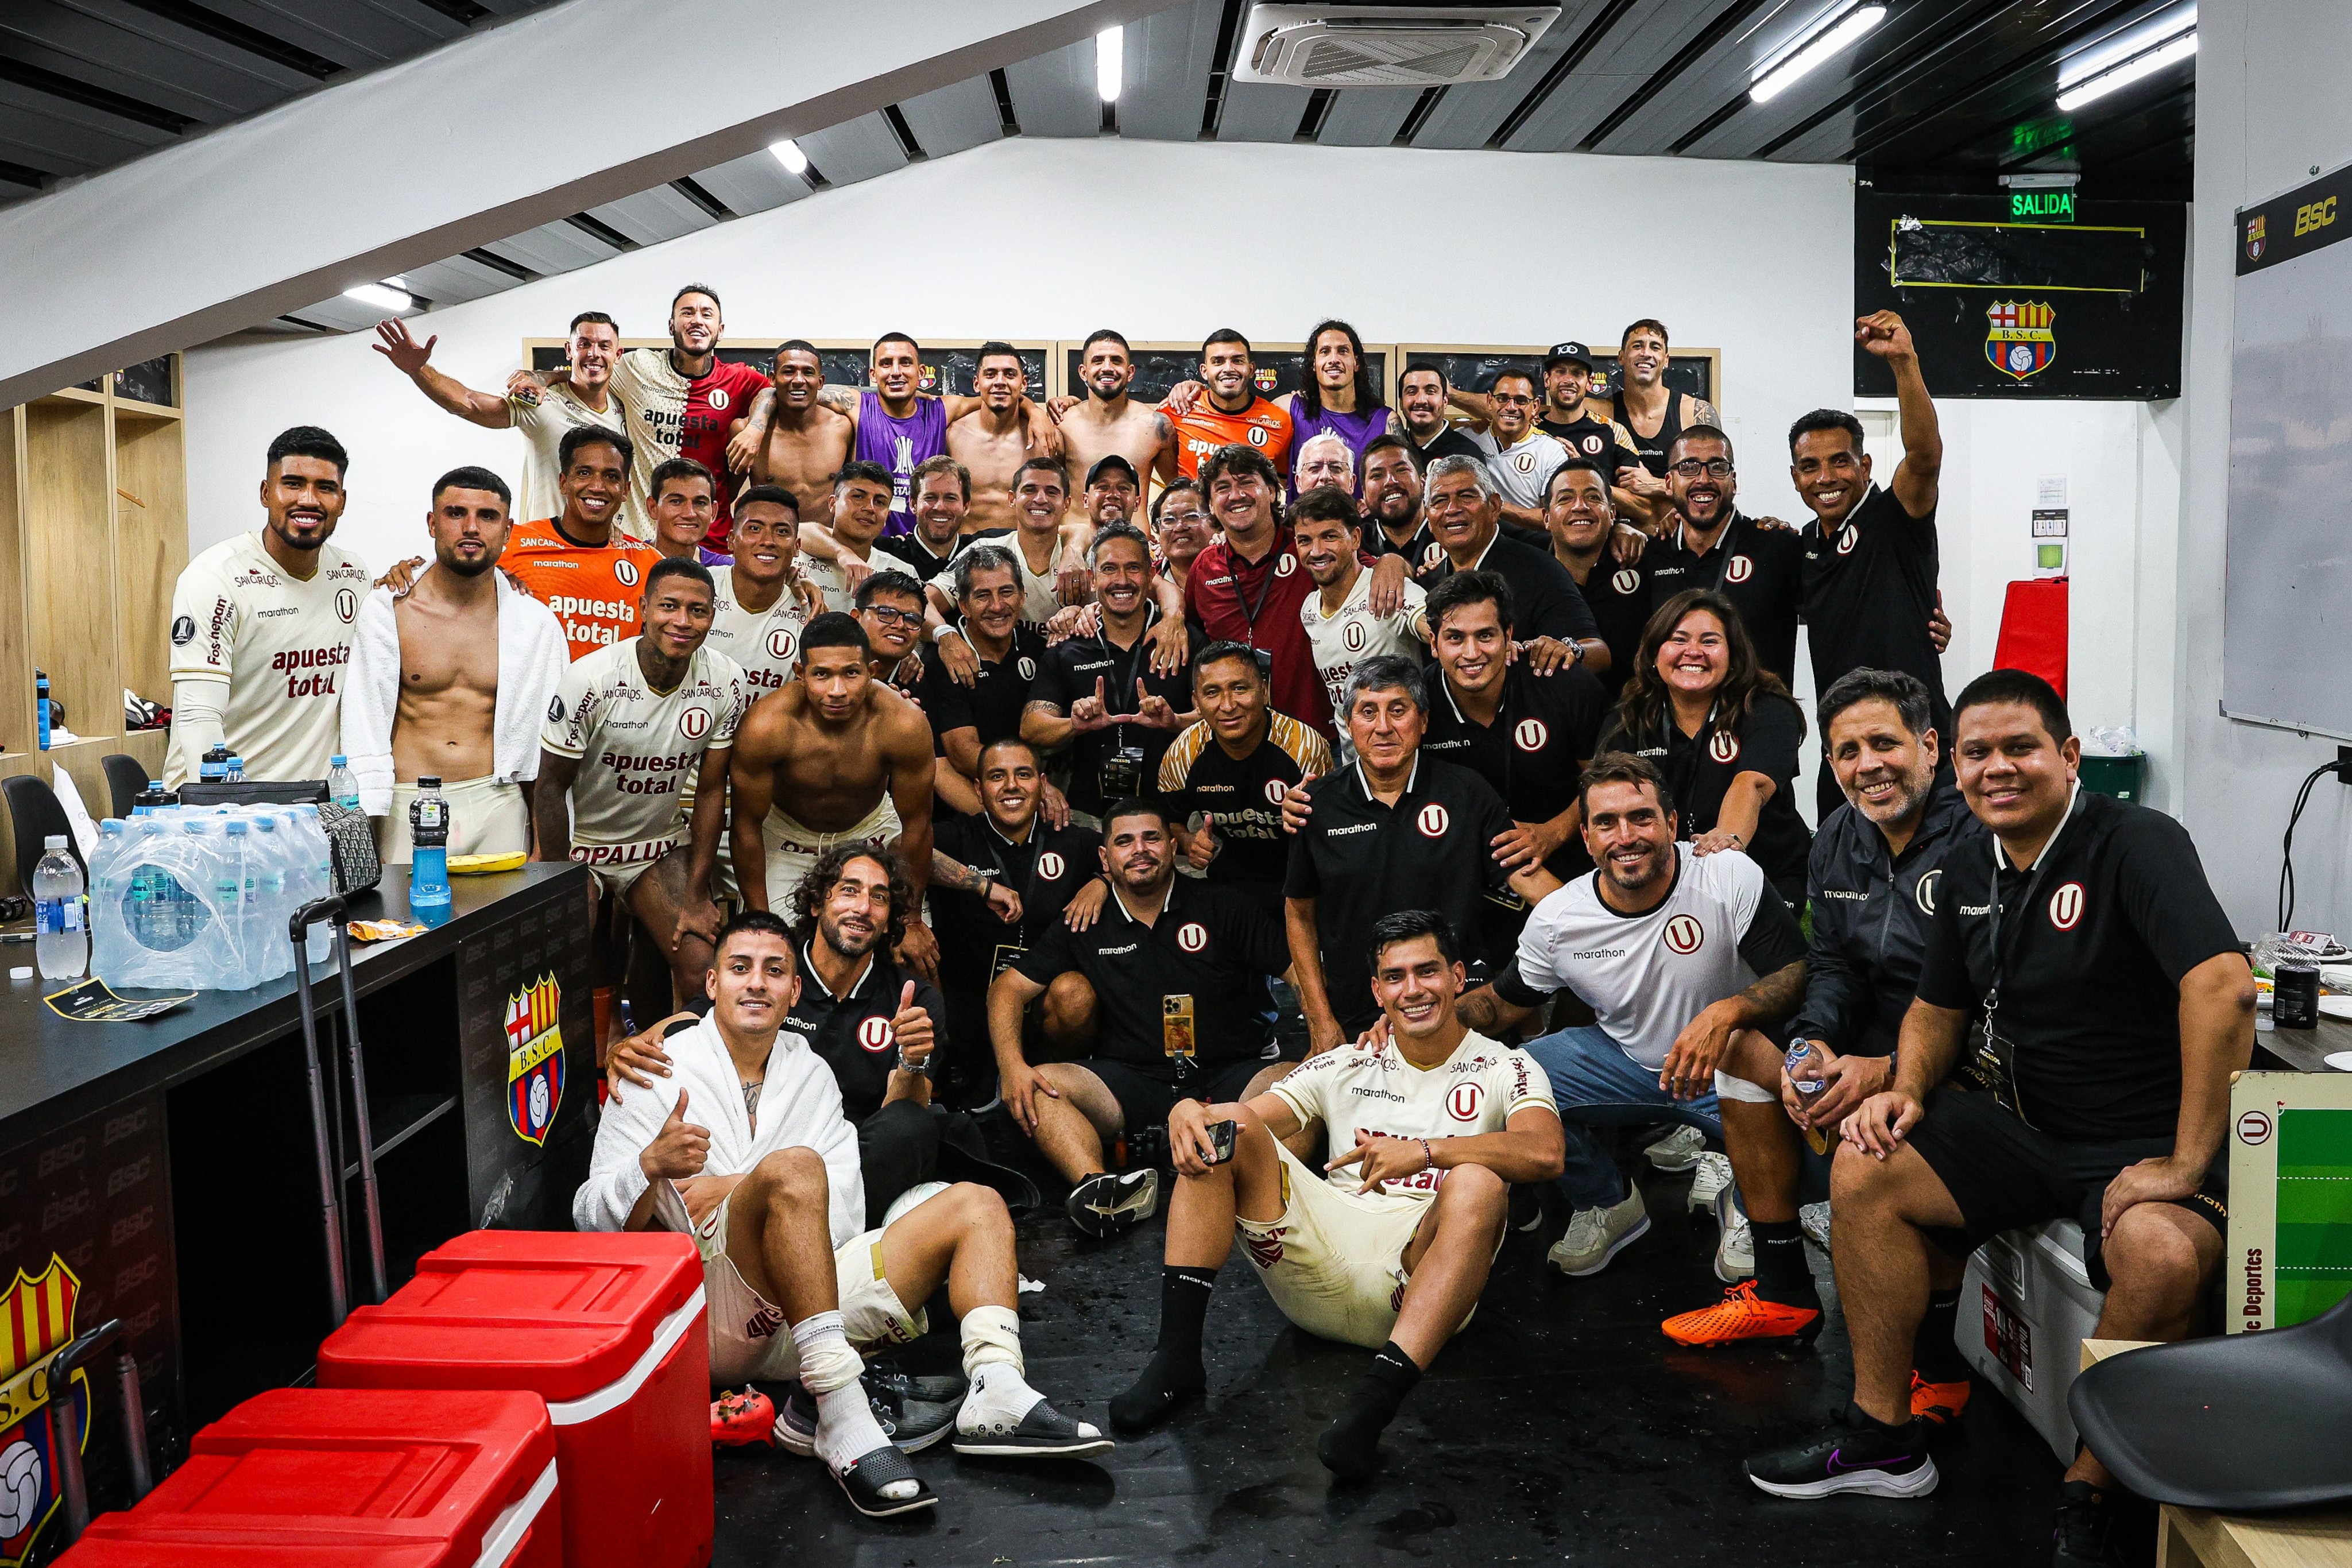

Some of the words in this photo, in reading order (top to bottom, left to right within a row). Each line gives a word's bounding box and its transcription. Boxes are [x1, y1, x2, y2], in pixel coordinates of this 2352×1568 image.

[2013, 193, 2072, 215] SALIDA
[2294, 196, 2336, 237] BSC
[1556, 346, 1577, 355] 100
[566, 417, 592, 428] marath
[644, 408, 719, 432] apuesta
[1181, 417, 1216, 428] marathon
[656, 428, 700, 450] total
[1638, 448, 1664, 456] arathon
[893, 477, 910, 485] CONME
[520, 537, 536, 547] SAN
[533, 560, 579, 569] marathon
[327, 569, 341, 580] SAN
[819, 584, 840, 593] athon
[258, 607, 299, 619] marathon
[548, 595, 635, 623] apuesta
[566, 619, 620, 645] total
[709, 629, 734, 639] athon
[272, 641, 351, 676] apuesta
[1074, 659, 1115, 671] marathon
[1320, 661, 1353, 683] uest
[288, 671, 336, 699] total
[603, 719, 648, 729] marathon
[1637, 746, 1668, 757] marath
[601, 751, 699, 773] apuesta
[616, 775, 676, 795] total
[1327, 822, 1377, 837] marathon
[1424, 808, 1443, 834] U
[1223, 825, 1279, 841] total
[570, 839, 678, 866] OPALUX
[969, 864, 1000, 877] mratho
[1042, 856, 1059, 877] U
[1960, 904, 2003, 916] marathn
[2057, 889, 2078, 925] U
[1183, 927, 1201, 950] U
[1670, 920, 1696, 950] U
[1573, 948, 1625, 960] marathon
[784, 1016, 817, 1031] rathon
[866, 1021, 887, 1047] U
[1314, 1060, 1336, 1071] Forte
[1450, 1062, 1470, 1073] SAN
[1352, 1086, 1405, 1104] marathon
[1456, 1089, 1475, 1117] U
[2243, 1119, 2268, 1137] U
[1384, 1166, 1442, 1192] tal
[2242, 1248, 2265, 1316] Deportes
